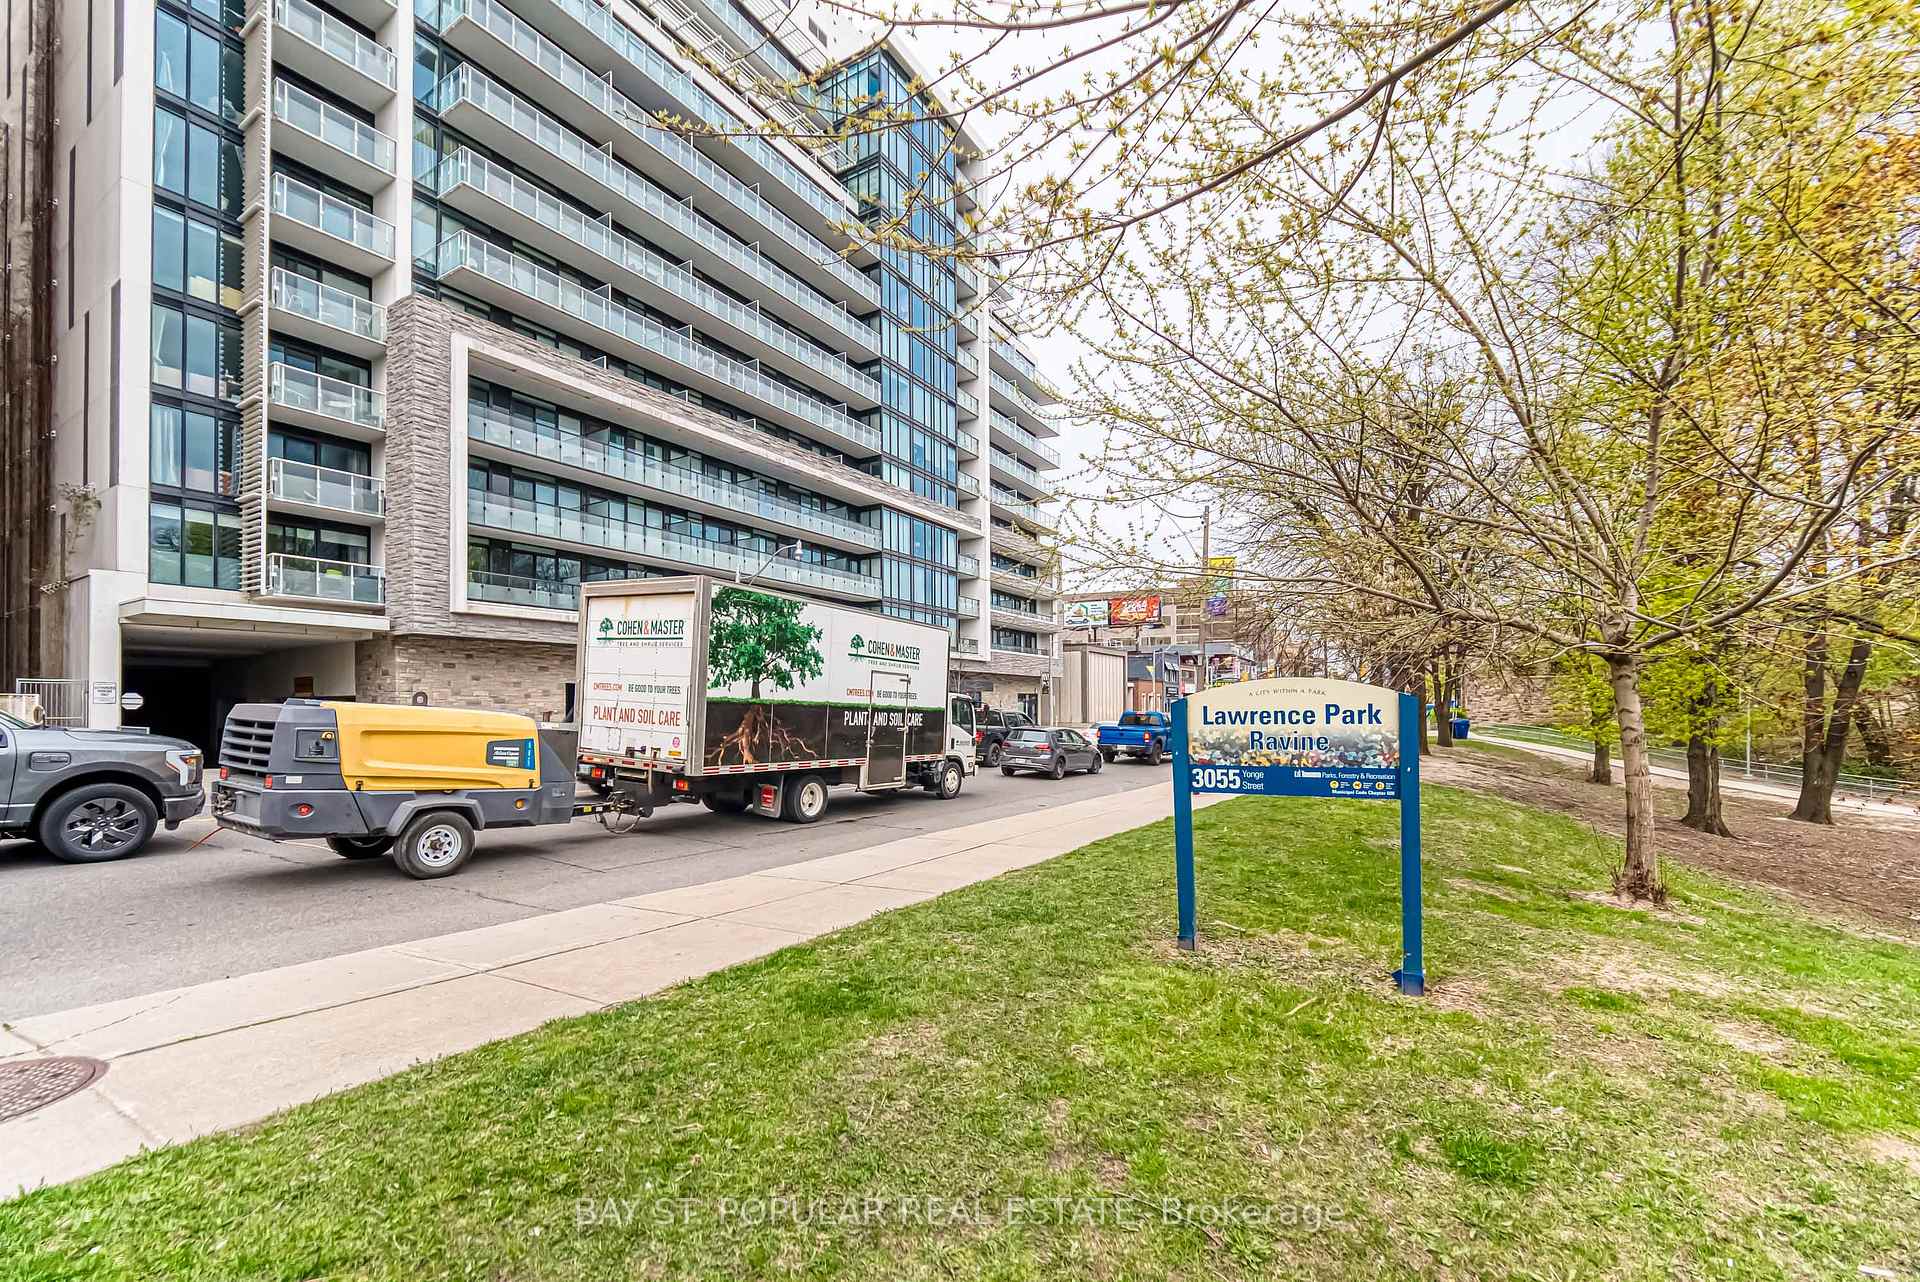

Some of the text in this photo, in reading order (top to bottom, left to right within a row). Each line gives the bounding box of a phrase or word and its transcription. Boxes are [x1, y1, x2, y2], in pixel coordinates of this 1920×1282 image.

[593, 705, 681, 727] PLANT AND SOIL CARE
[843, 710, 924, 727] PLANT AND SOIL CARE
[1202, 703, 1383, 726] Lawrence Park
[1250, 731, 1330, 751] Ravine
[1191, 768, 1265, 790] 3055 Yonge
[1242, 781, 1265, 791] Street
